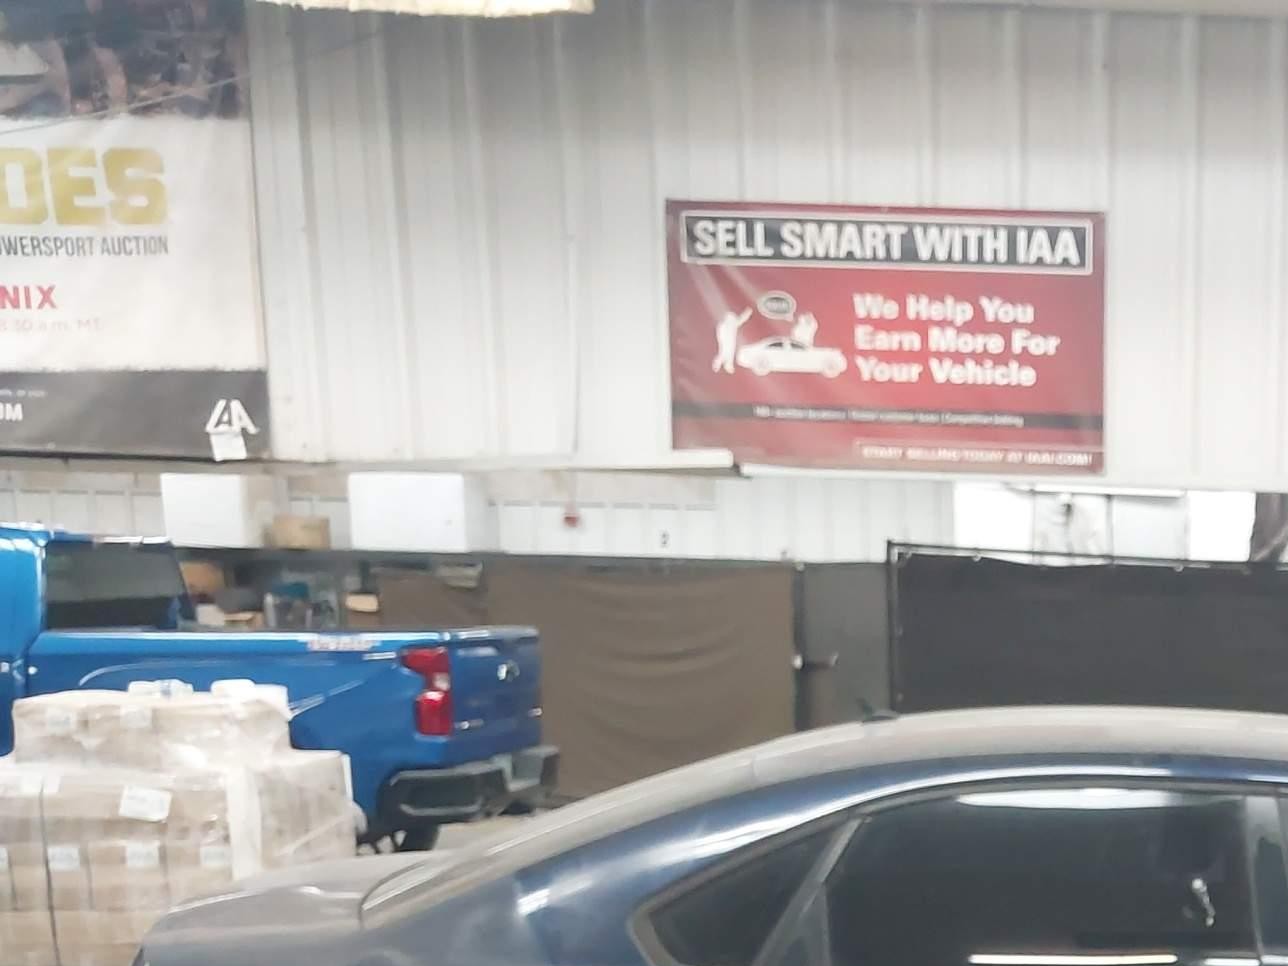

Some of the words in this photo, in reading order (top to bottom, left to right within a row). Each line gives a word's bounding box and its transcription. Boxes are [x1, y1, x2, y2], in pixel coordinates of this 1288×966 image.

[0, 235, 95, 257] WERSPORT
[101, 235, 168, 256] AUCTION
[693, 219, 774, 257] SELL
[780, 220, 908, 261] SMART
[912, 224, 1008, 263] WITH
[1016, 226, 1080, 266] IAA
[853, 293, 900, 320] We
[906, 293, 974, 327] Help
[979, 295, 1035, 324] You
[853, 324, 922, 351] Earn
[927, 326, 1005, 354] More
[1011, 328, 1061, 355] For
[854, 355, 923, 382] Your
[928, 357, 1037, 387] Vehicle
